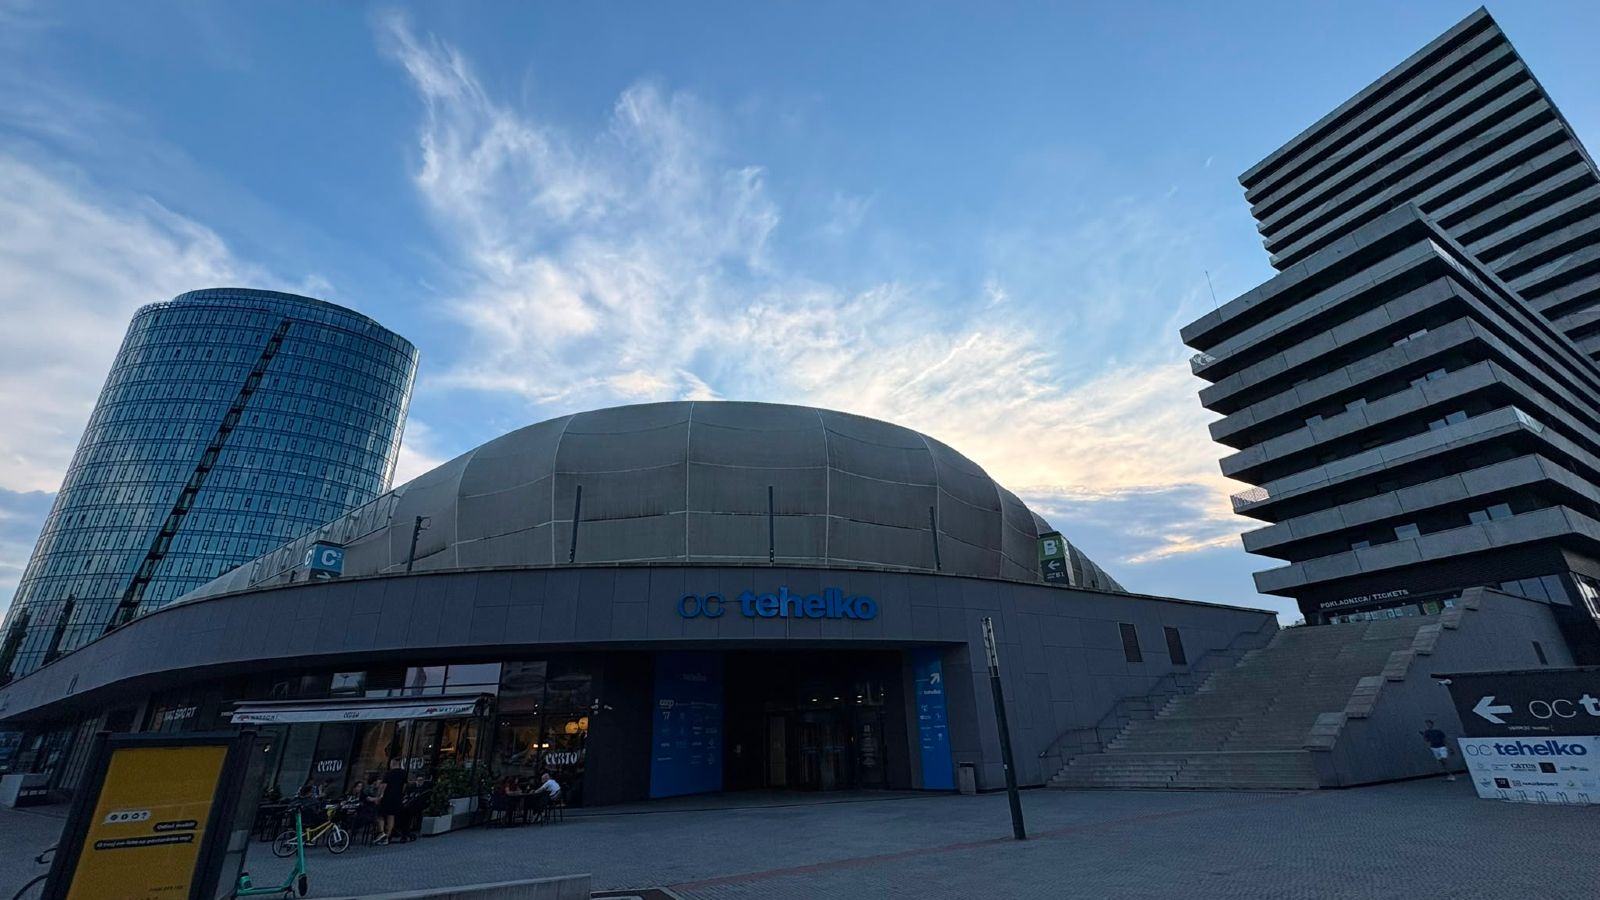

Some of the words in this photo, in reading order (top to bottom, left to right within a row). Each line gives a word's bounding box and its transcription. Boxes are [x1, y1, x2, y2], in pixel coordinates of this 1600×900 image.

[678, 593, 725, 618] OC
[740, 586, 877, 619] tehelko
[1528, 699, 1577, 719] OC
[1578, 694, 1600, 716] t
[1465, 744, 1493, 757] OC
[1493, 740, 1588, 756] tehelko
